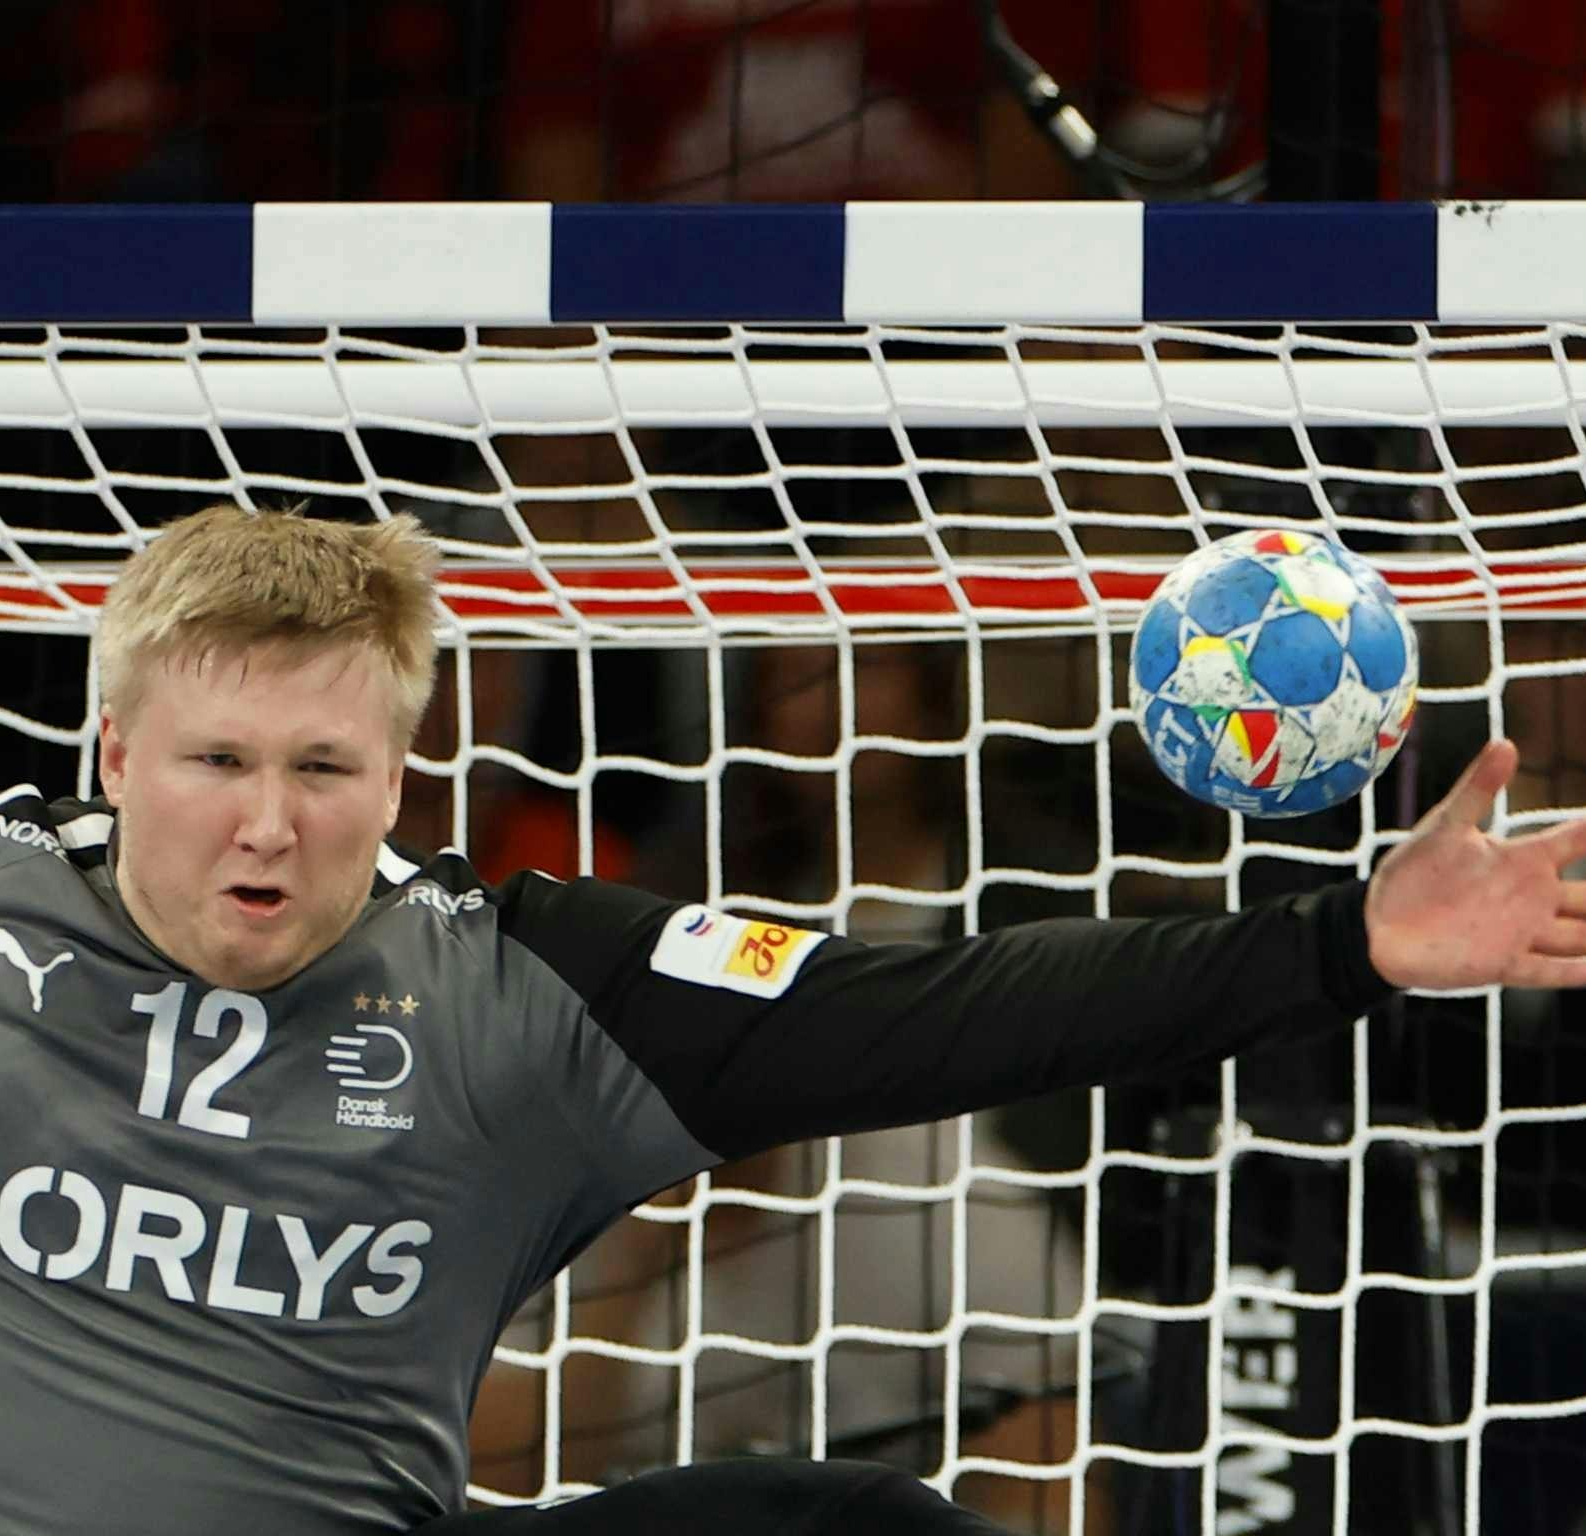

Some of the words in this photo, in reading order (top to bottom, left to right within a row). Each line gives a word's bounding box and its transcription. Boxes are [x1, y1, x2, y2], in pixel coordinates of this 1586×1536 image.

[392, 886, 485, 916] RLYS
[131, 982, 269, 1139] 12
[337, 1095, 389, 1114] Dansk
